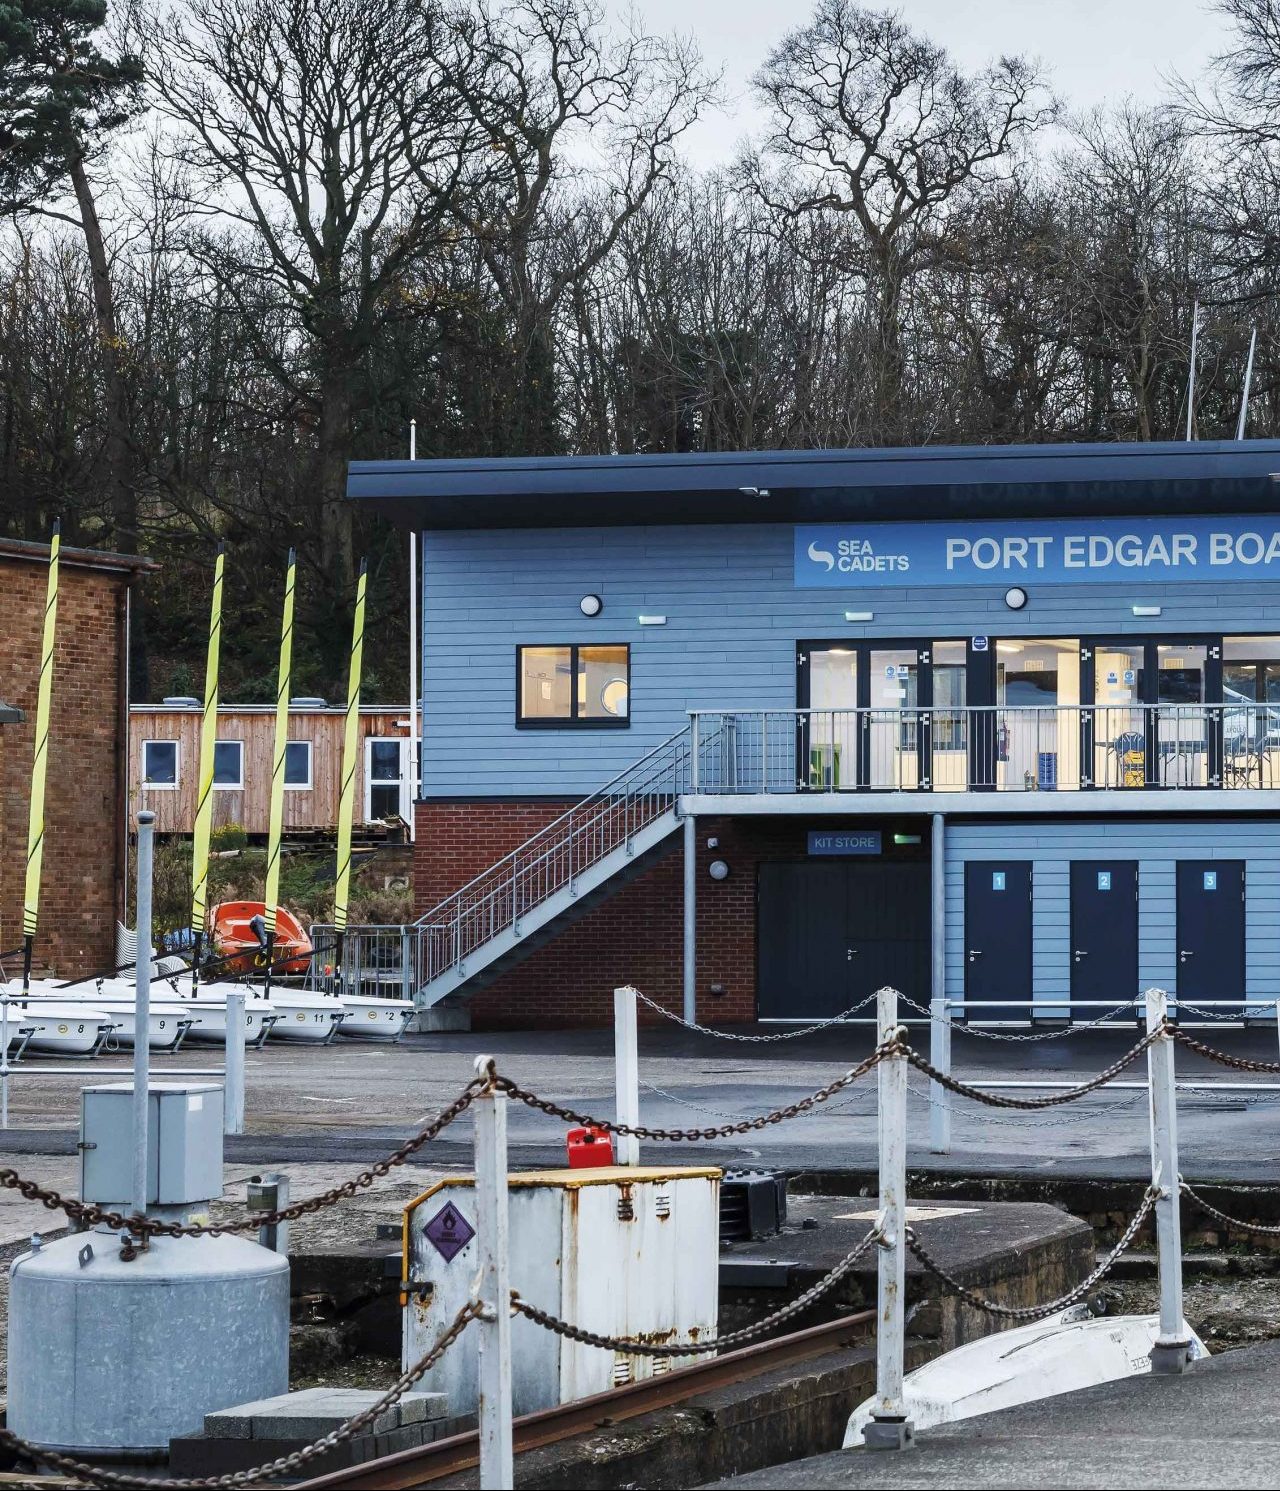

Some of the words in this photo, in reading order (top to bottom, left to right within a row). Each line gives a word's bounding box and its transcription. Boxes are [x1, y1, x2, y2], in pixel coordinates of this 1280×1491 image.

[837, 540, 874, 556] SEA
[946, 536, 1054, 570] PORT
[1063, 533, 1198, 568] EDGAR
[837, 555, 910, 573] CADETS
[815, 837, 833, 848] KIT
[835, 837, 875, 848] STORE
[996, 875, 1002, 886] 1
[1100, 875, 1108, 886] 2
[1207, 876, 1214, 886] 3
[246, 1015, 253, 1026] 0
[314, 1014, 324, 1023] 11
[385, 1012, 395, 1021] 2
[77, 1024, 85, 1034] 8
[159, 1020, 166, 1030] 9
